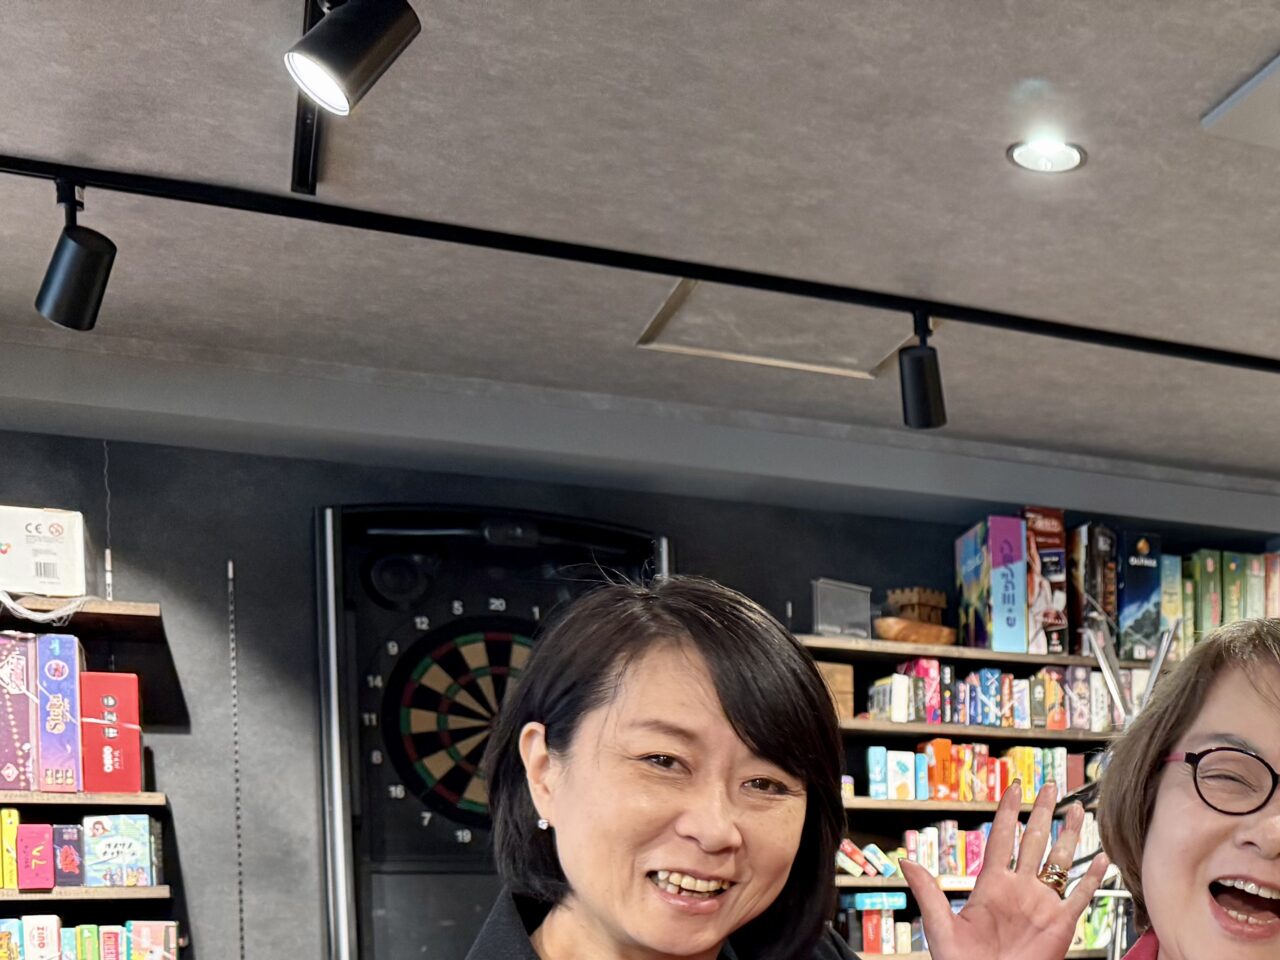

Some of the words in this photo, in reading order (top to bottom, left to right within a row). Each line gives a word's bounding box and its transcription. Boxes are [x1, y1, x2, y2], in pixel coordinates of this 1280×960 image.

[452, 601, 463, 615] 5
[489, 598, 506, 611] 20
[532, 606, 540, 619] 1
[415, 617, 430, 630] 12
[387, 641, 399, 656] 9
[367, 675, 383, 687] 14
[363, 713, 377, 726] 11
[389, 784, 405, 799] 16
[421, 812, 432, 826] 7
[456, 829, 471, 843] 19
